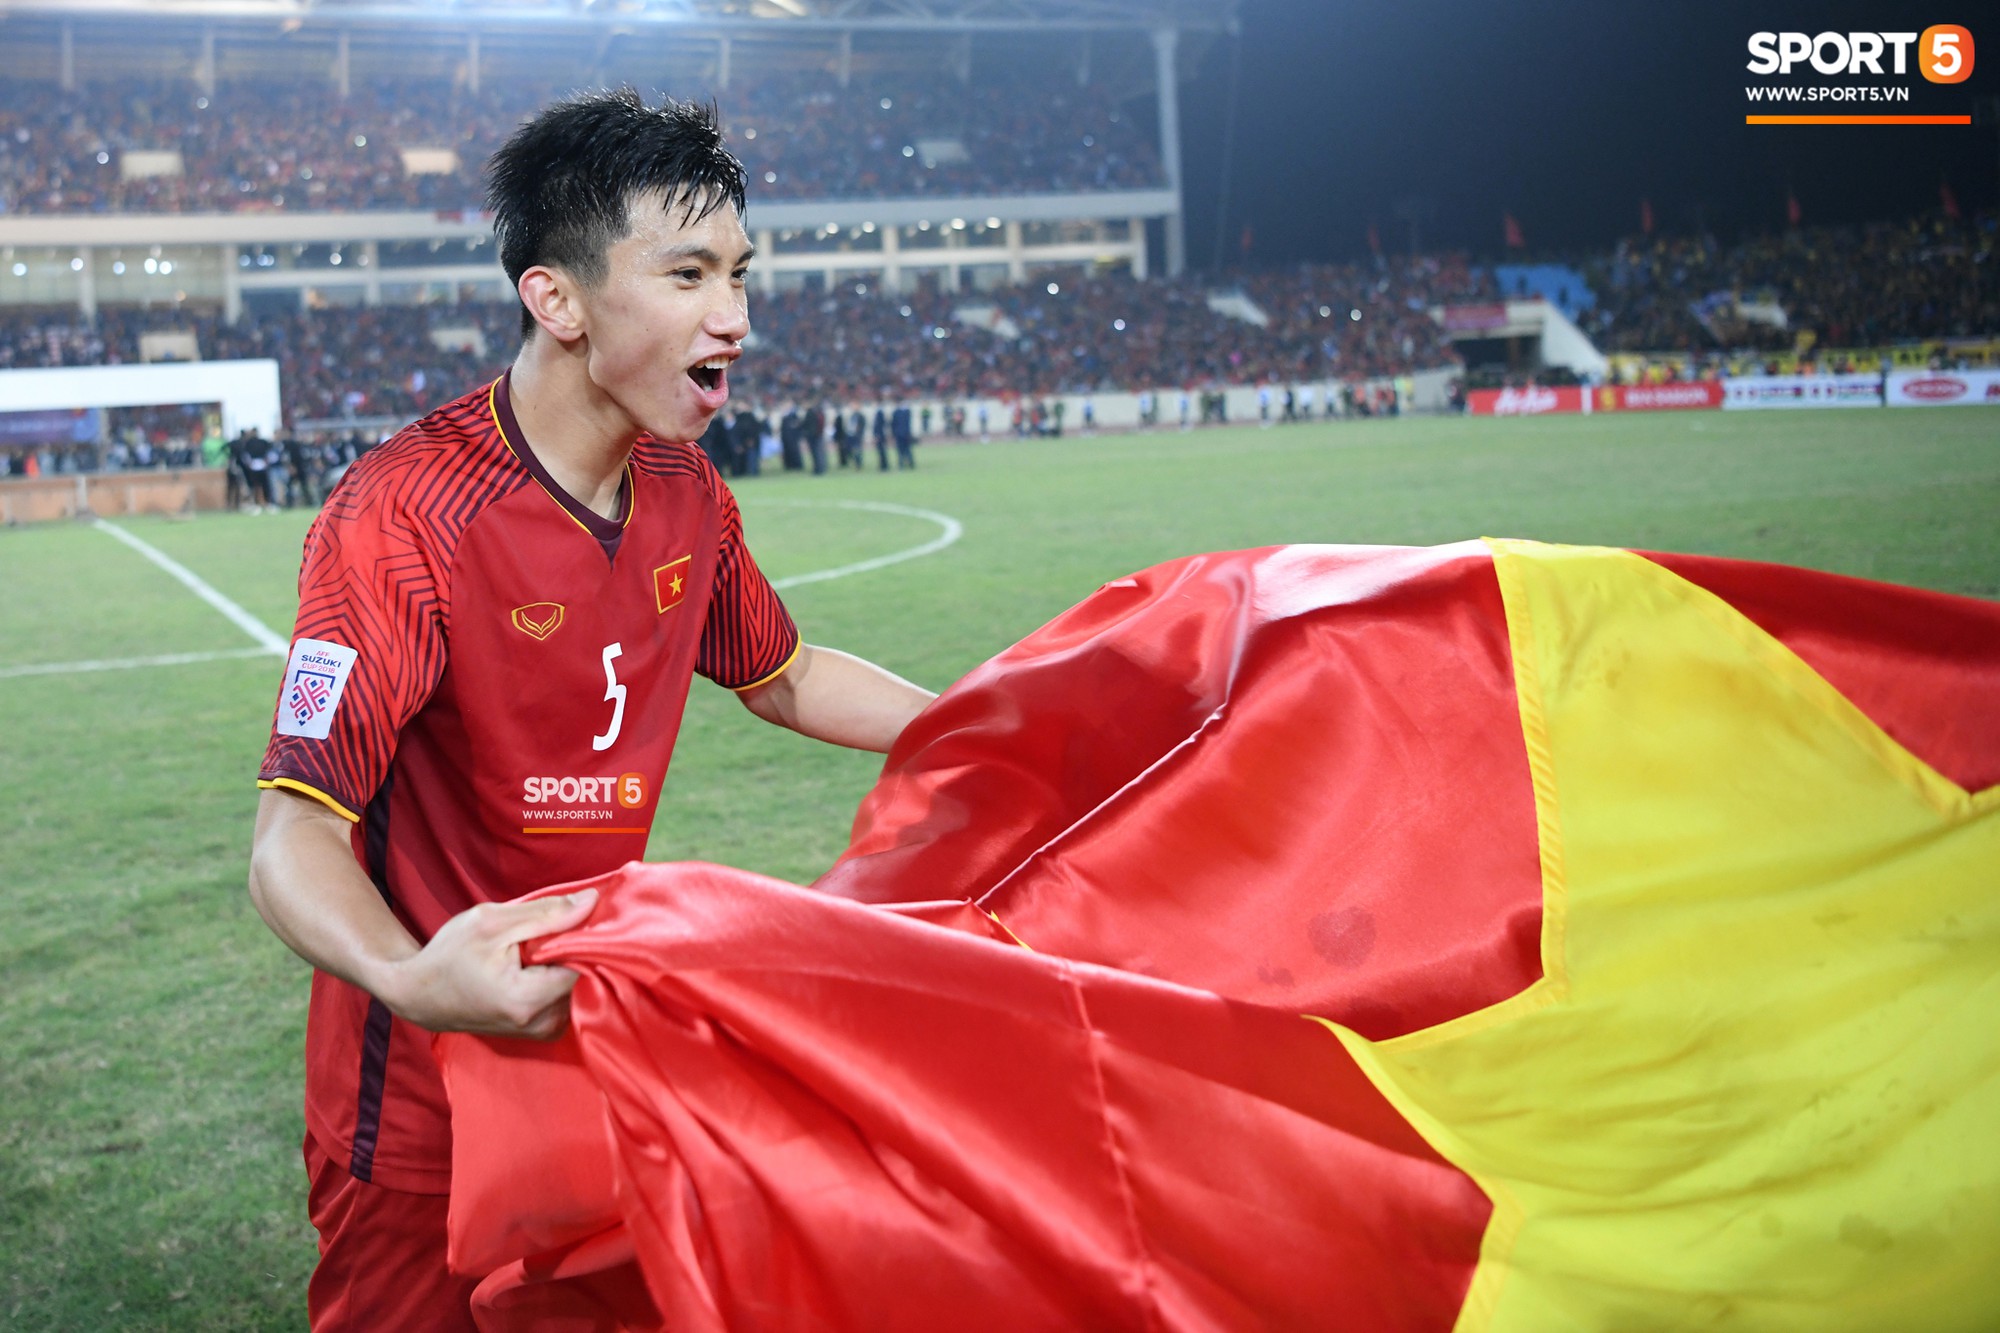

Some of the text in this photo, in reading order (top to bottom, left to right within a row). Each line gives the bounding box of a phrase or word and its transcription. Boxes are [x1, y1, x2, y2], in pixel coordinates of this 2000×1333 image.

[301, 654, 341, 668] SUZUKI
[301, 662, 318, 670] CUP
[592, 641, 627, 751] 5
